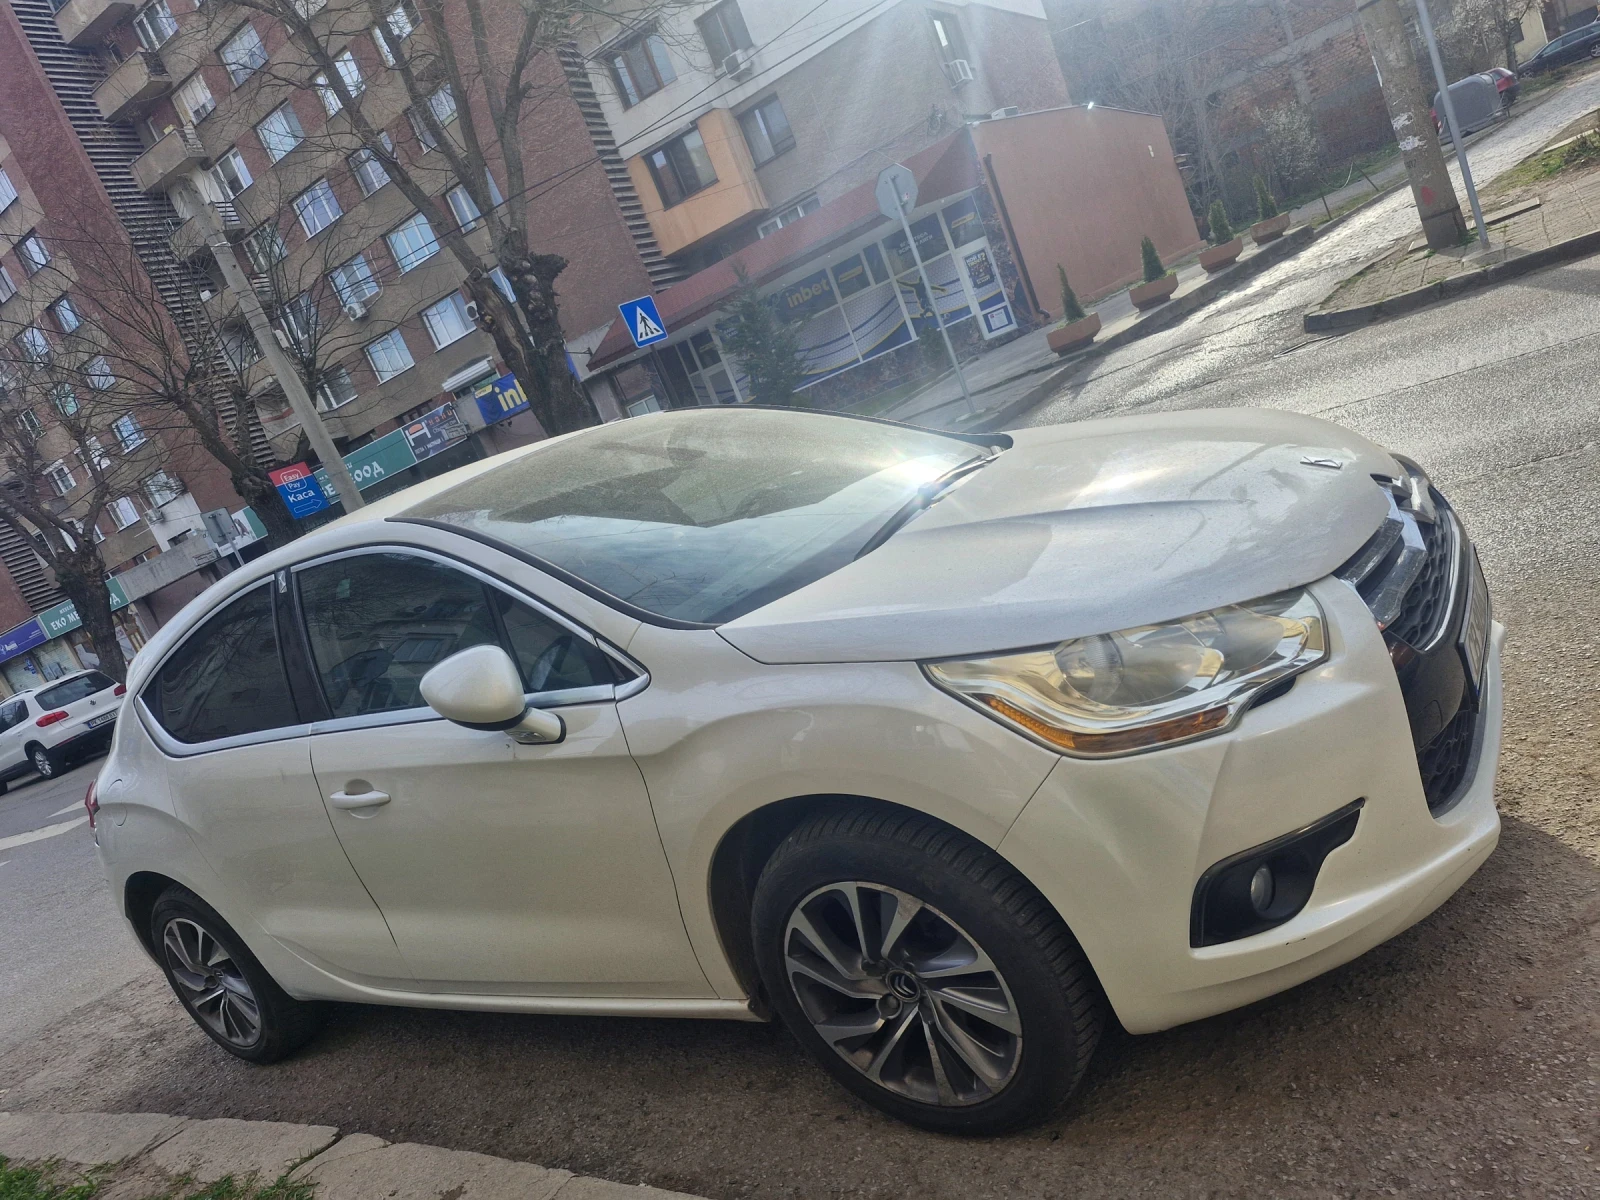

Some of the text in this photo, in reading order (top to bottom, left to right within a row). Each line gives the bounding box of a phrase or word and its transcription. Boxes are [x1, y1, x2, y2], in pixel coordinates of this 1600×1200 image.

[785, 278, 830, 308] inbet
[283, 473, 300, 482] Easy
[288, 482, 301, 490] Pay
[50, 617, 67, 631] ЕКО
